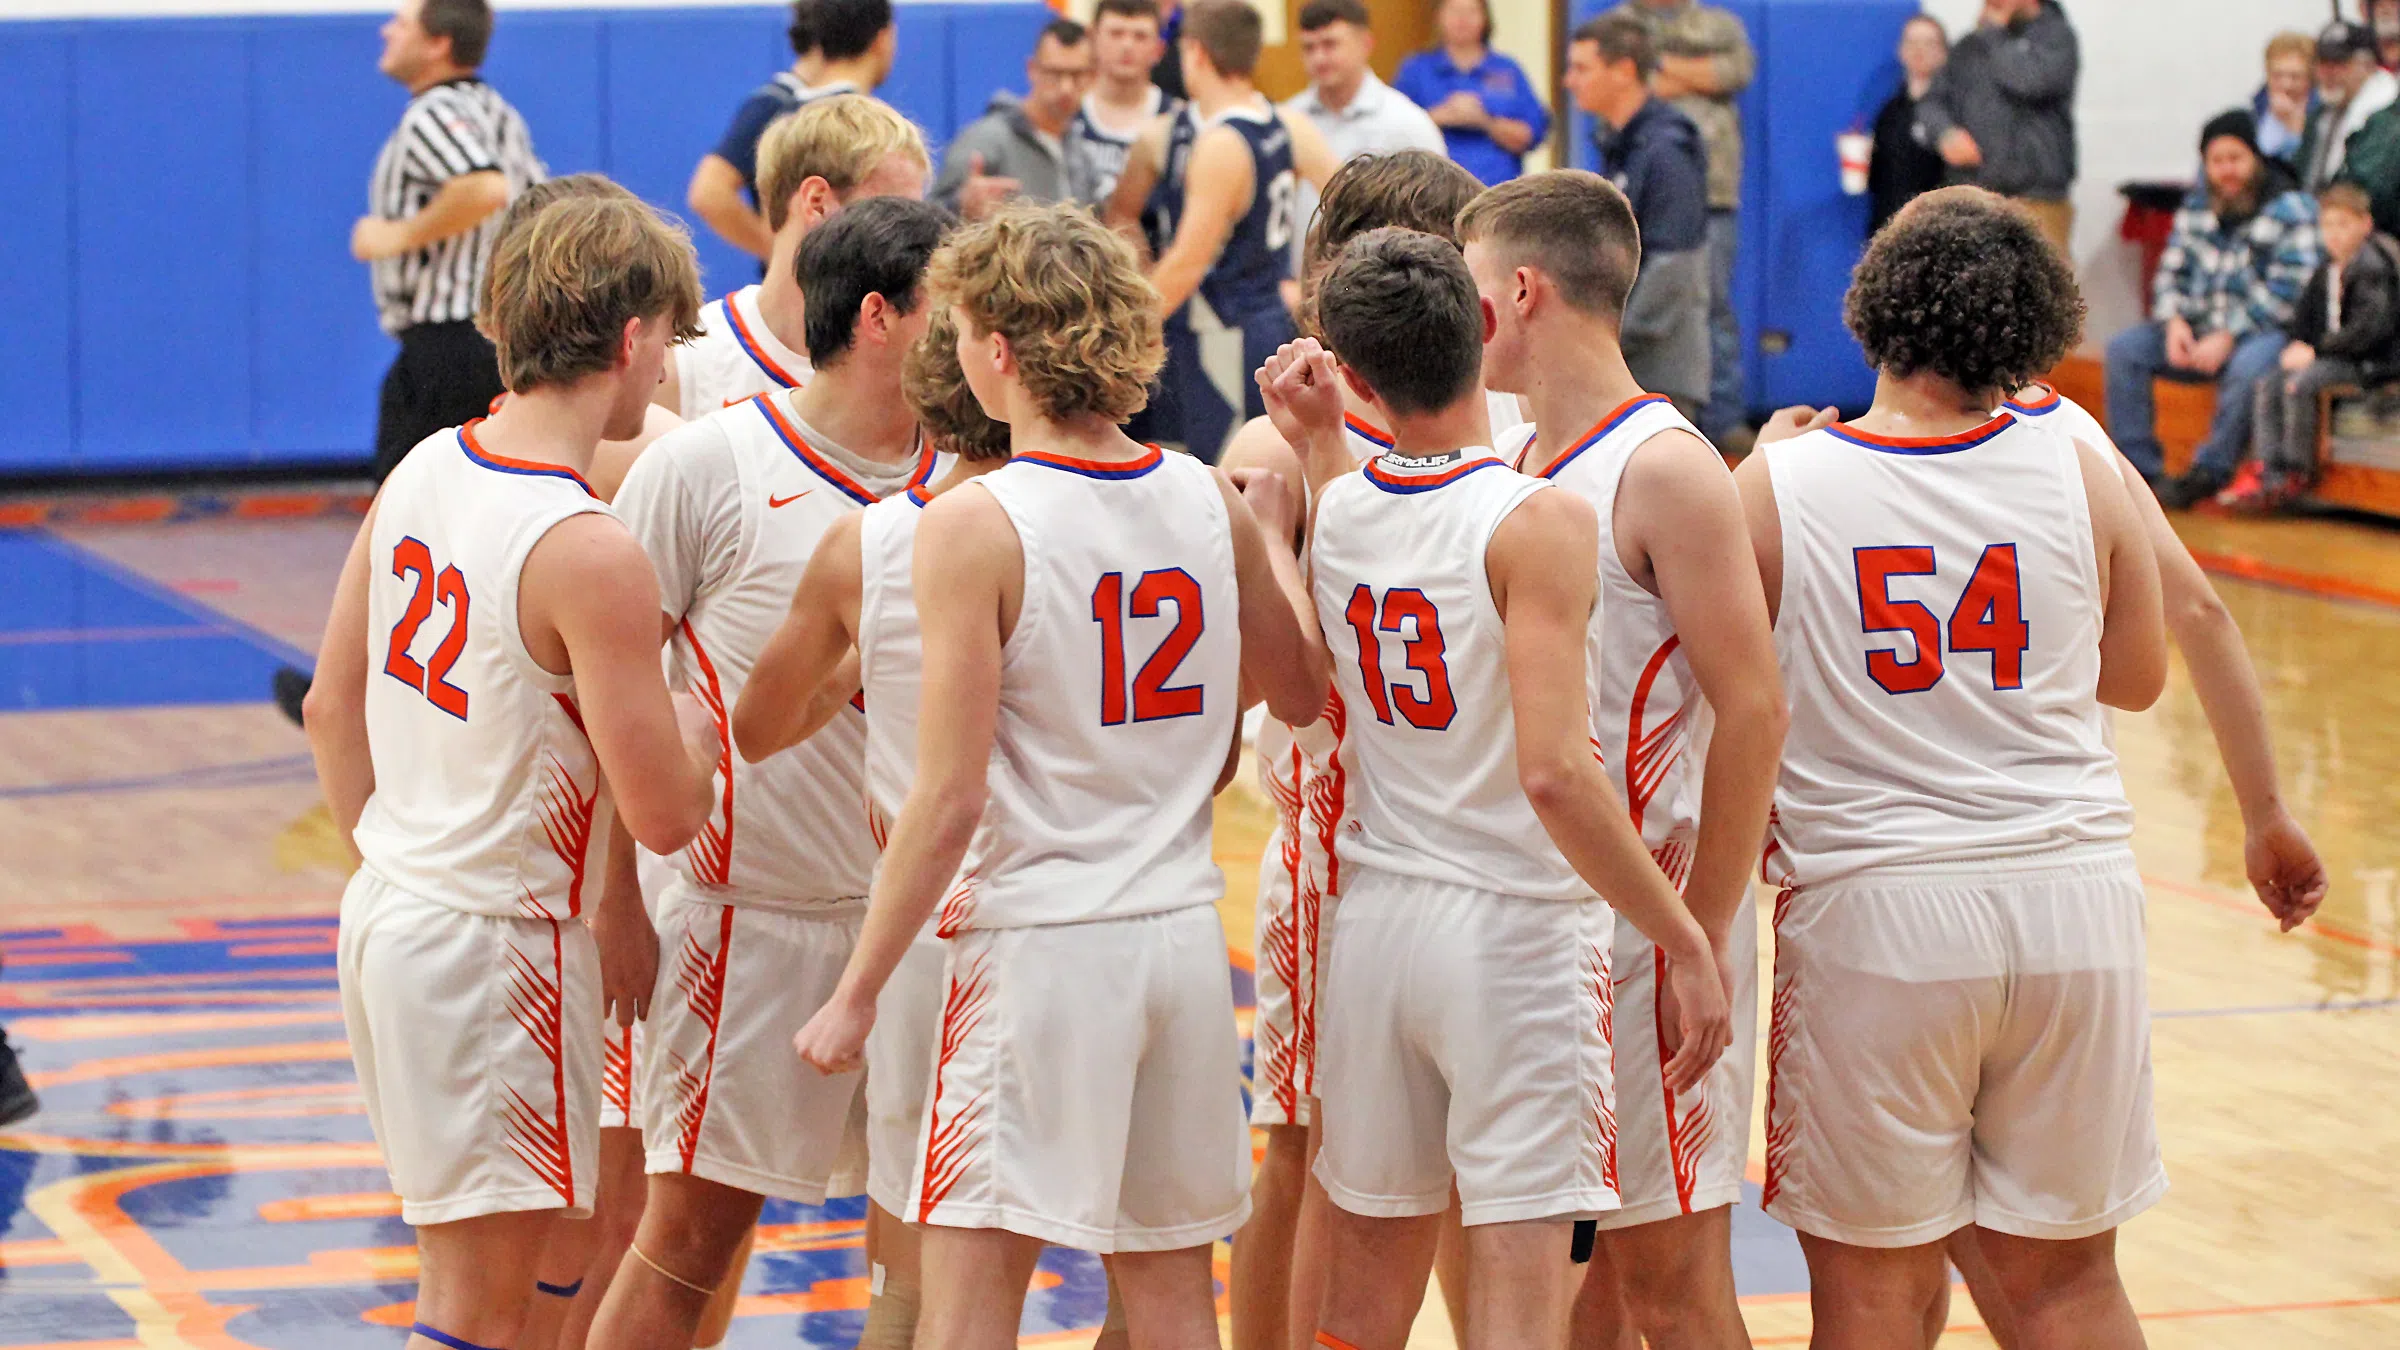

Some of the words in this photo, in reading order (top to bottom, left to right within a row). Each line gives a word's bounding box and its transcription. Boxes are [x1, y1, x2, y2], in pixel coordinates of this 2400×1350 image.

[384, 535, 469, 721] 22
[1092, 566, 1204, 727] 12
[1345, 583, 1458, 731] 13
[1852, 542, 2030, 695] 54
